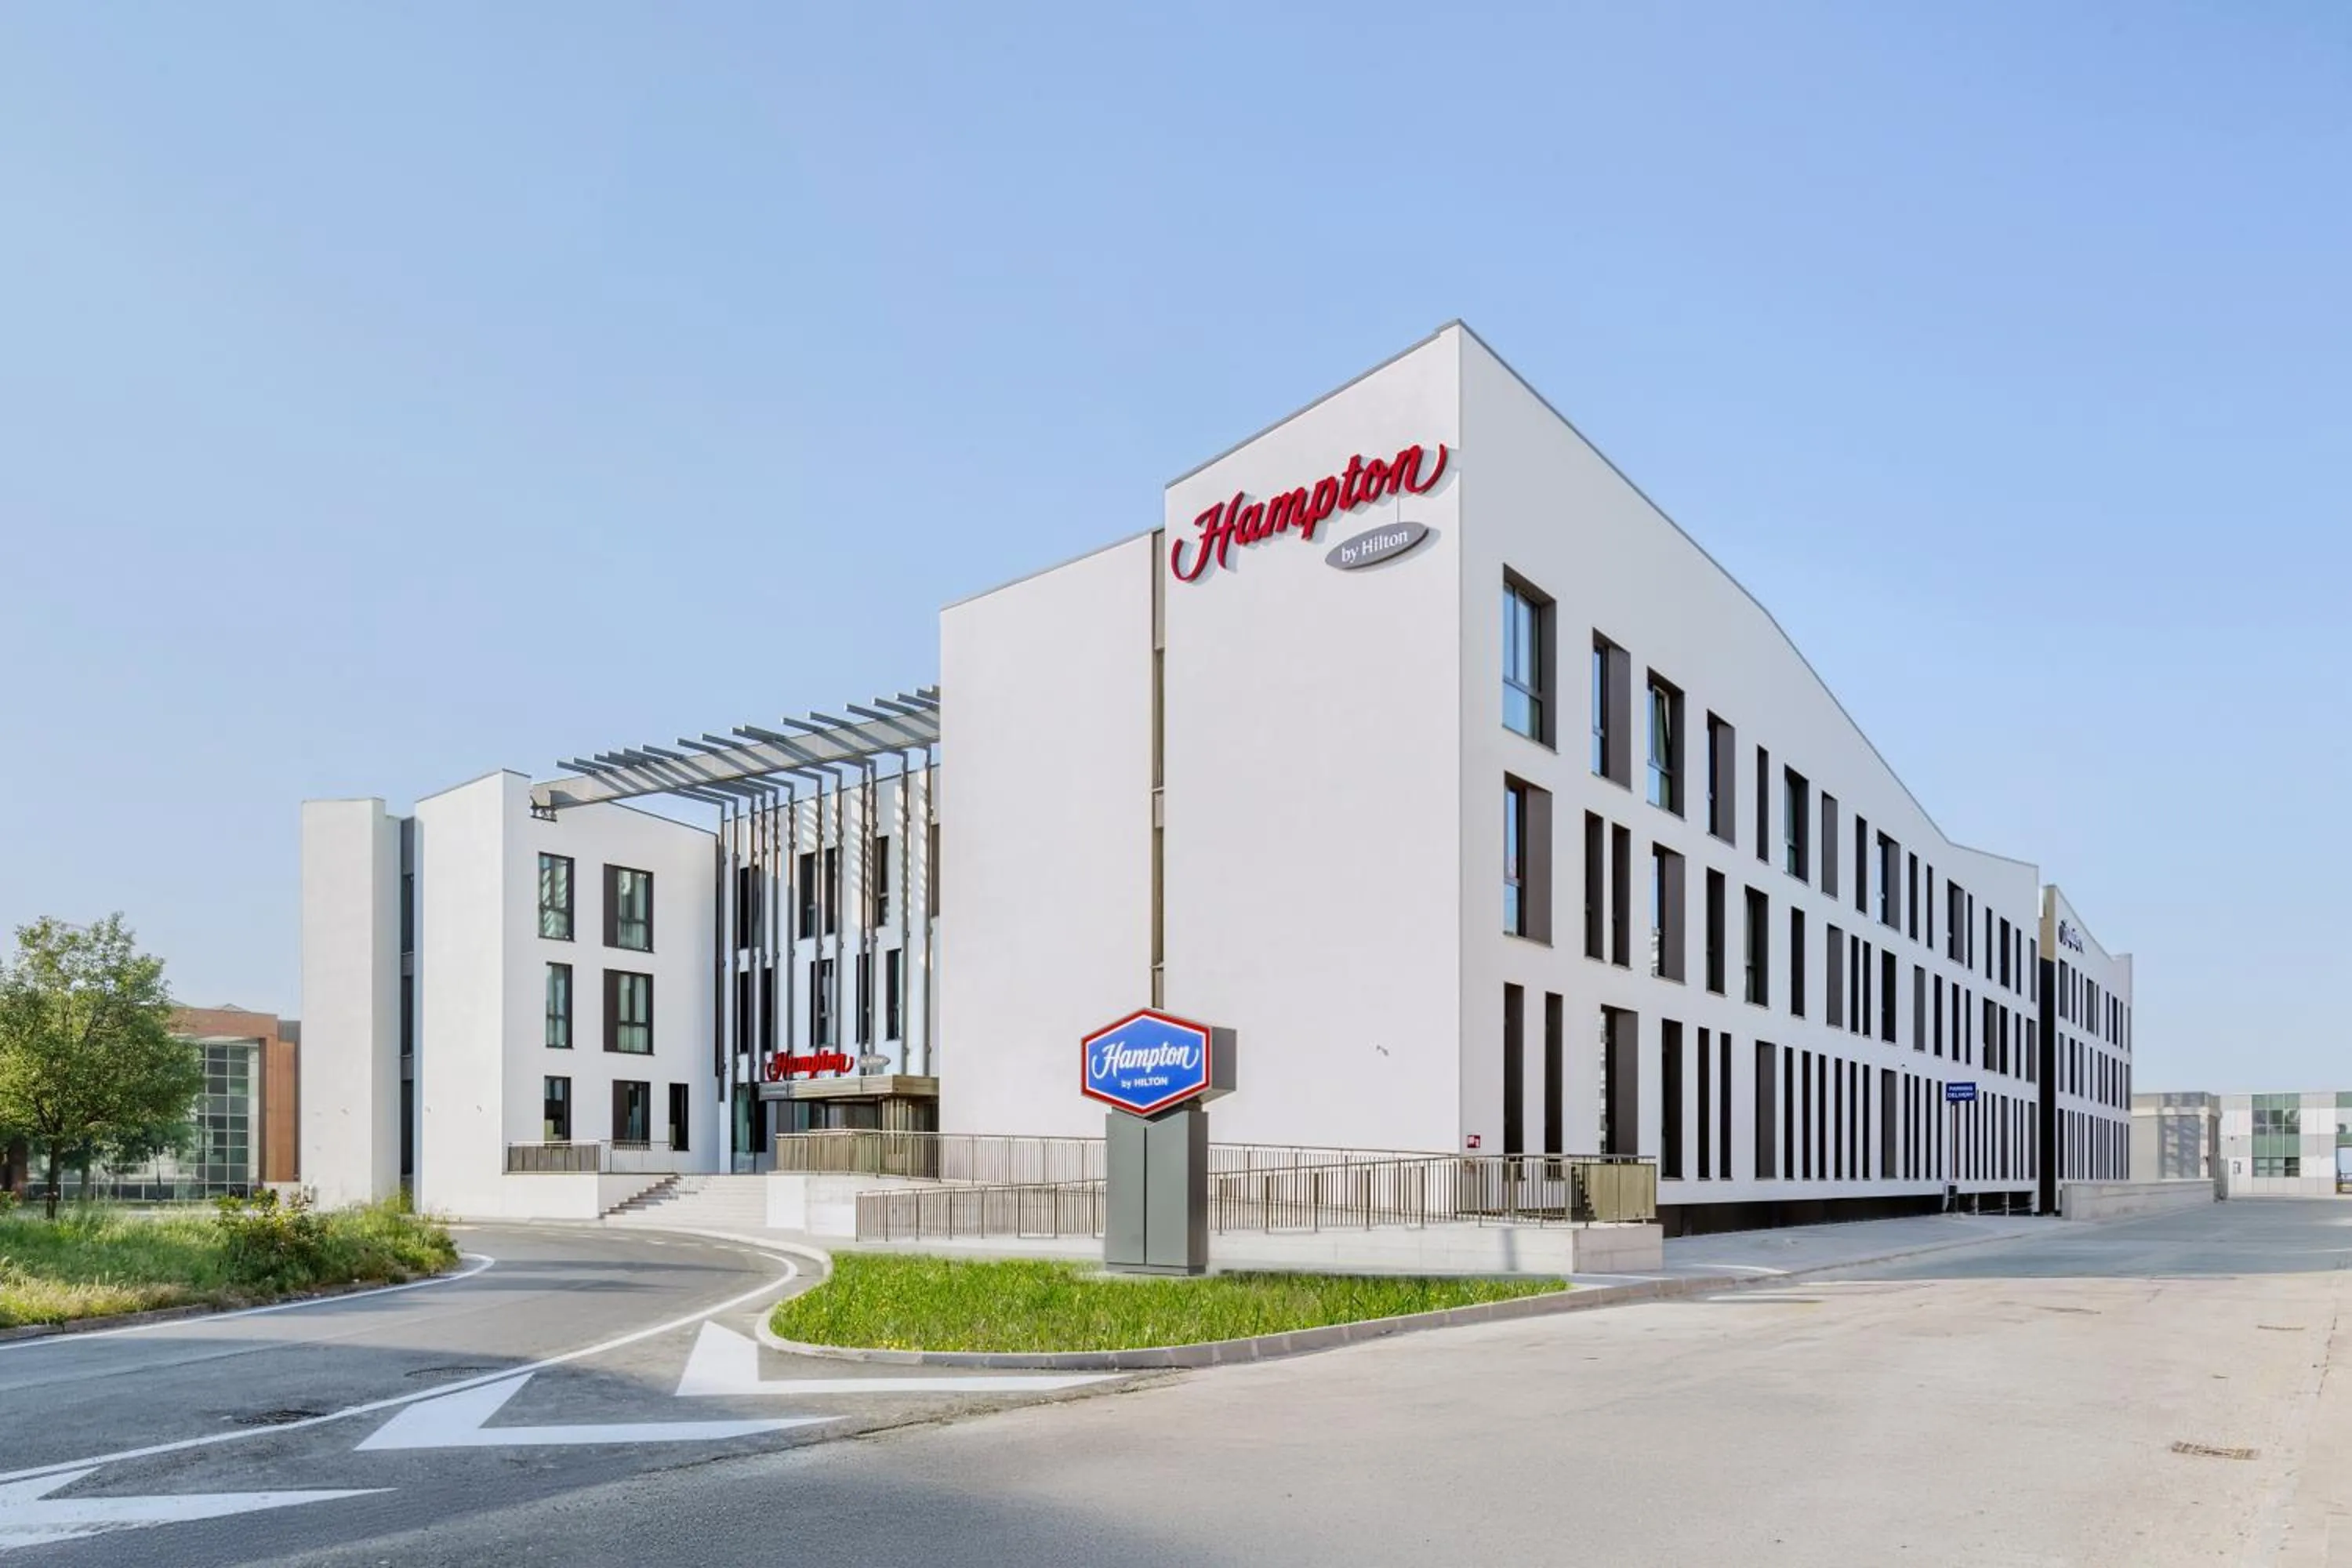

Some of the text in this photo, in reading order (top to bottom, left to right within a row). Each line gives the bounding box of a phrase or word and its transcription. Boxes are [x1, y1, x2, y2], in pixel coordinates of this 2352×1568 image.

[1171, 443, 1447, 583] Hampton
[1341, 531, 1408, 563] by Hilton
[766, 1049, 855, 1083] Hampton
[1091, 1041, 1200, 1080] Hampton
[1121, 1076, 1168, 1090] by HILTON
